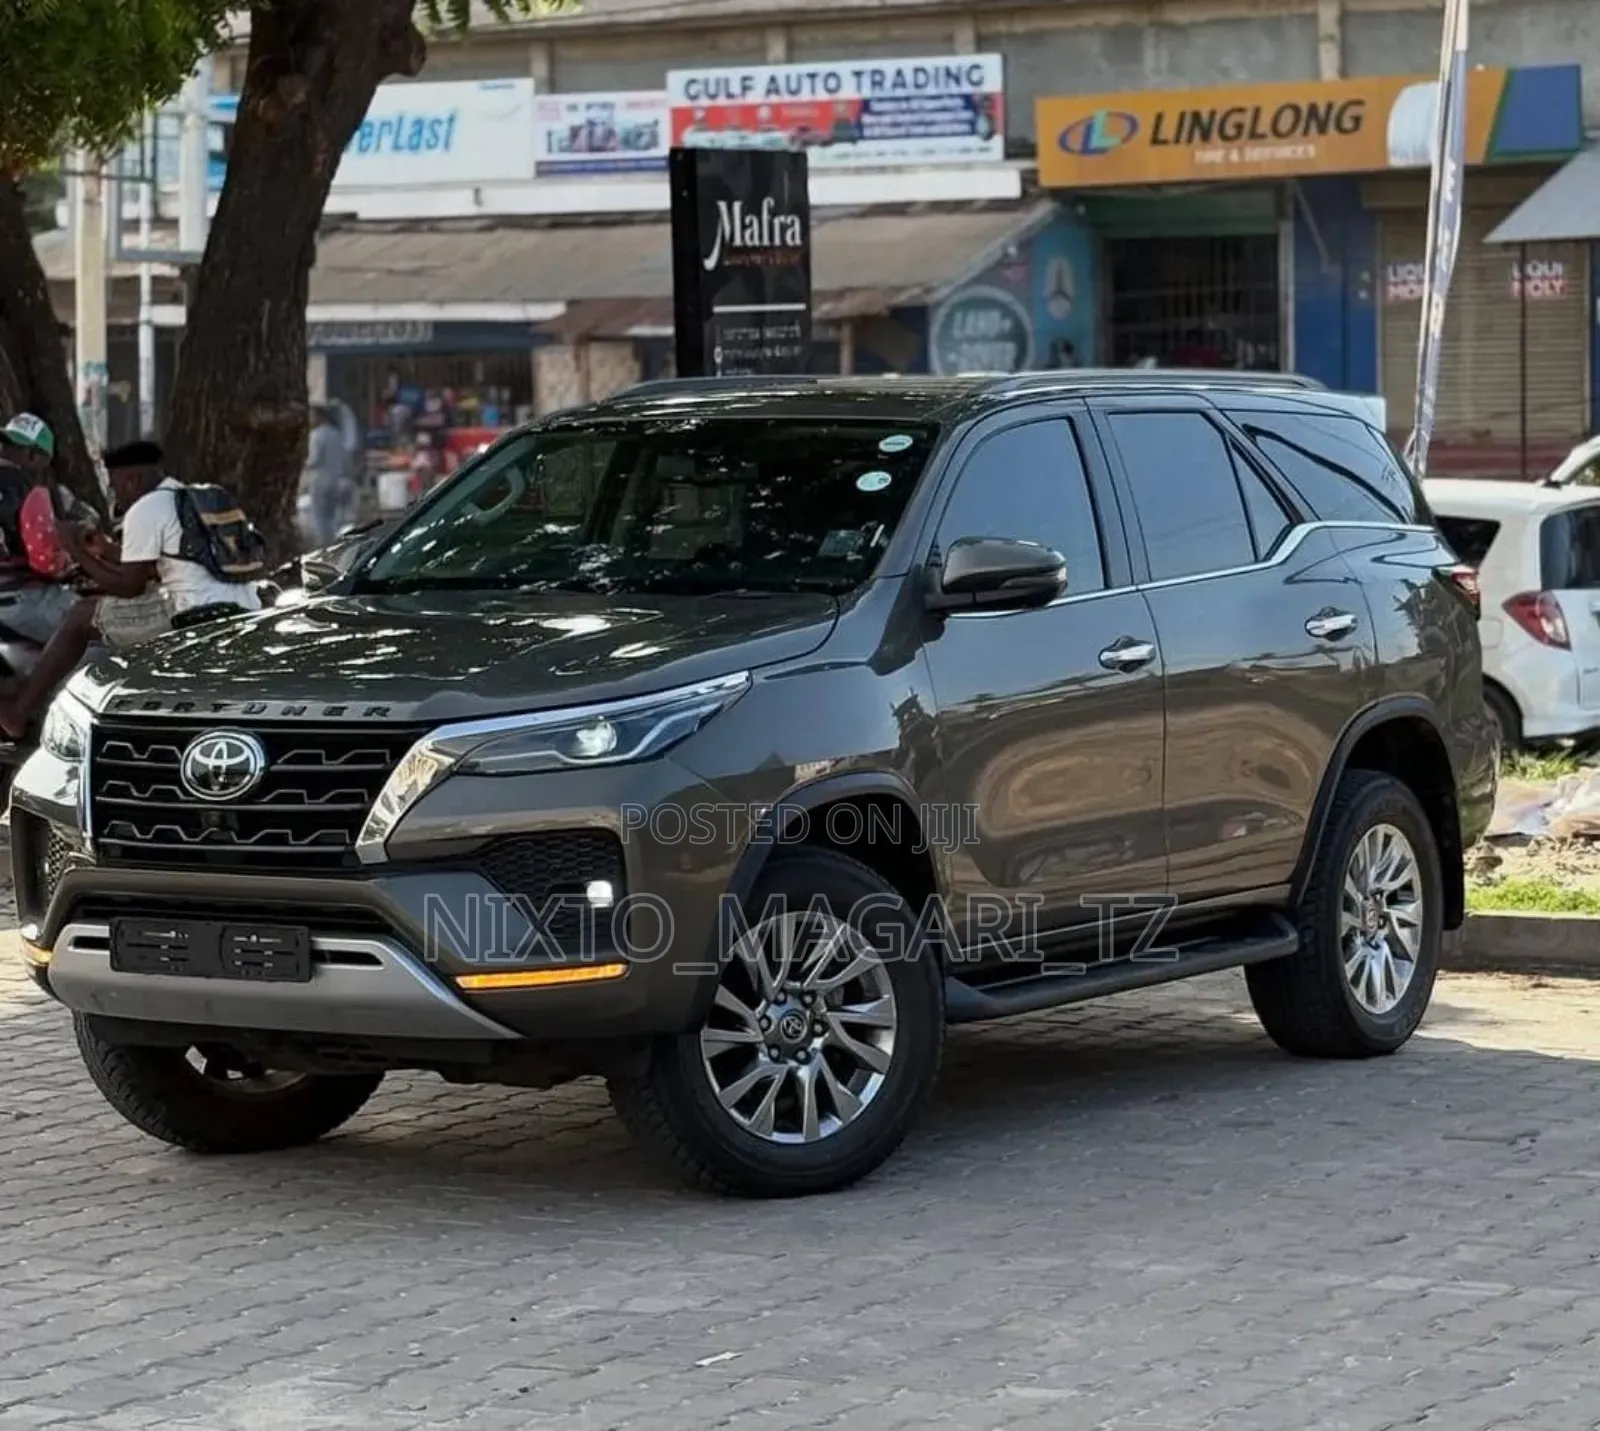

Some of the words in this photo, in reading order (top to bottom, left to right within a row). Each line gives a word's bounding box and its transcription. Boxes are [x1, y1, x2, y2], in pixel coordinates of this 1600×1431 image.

[684, 75, 754, 101] GULF
[765, 71, 842, 97] AUTO
[851, 64, 985, 92] TRADING
[1149, 99, 1365, 146] LINGLONG
[702, 196, 803, 272] Mafra
[104, 699, 392, 718] FORTUNER
